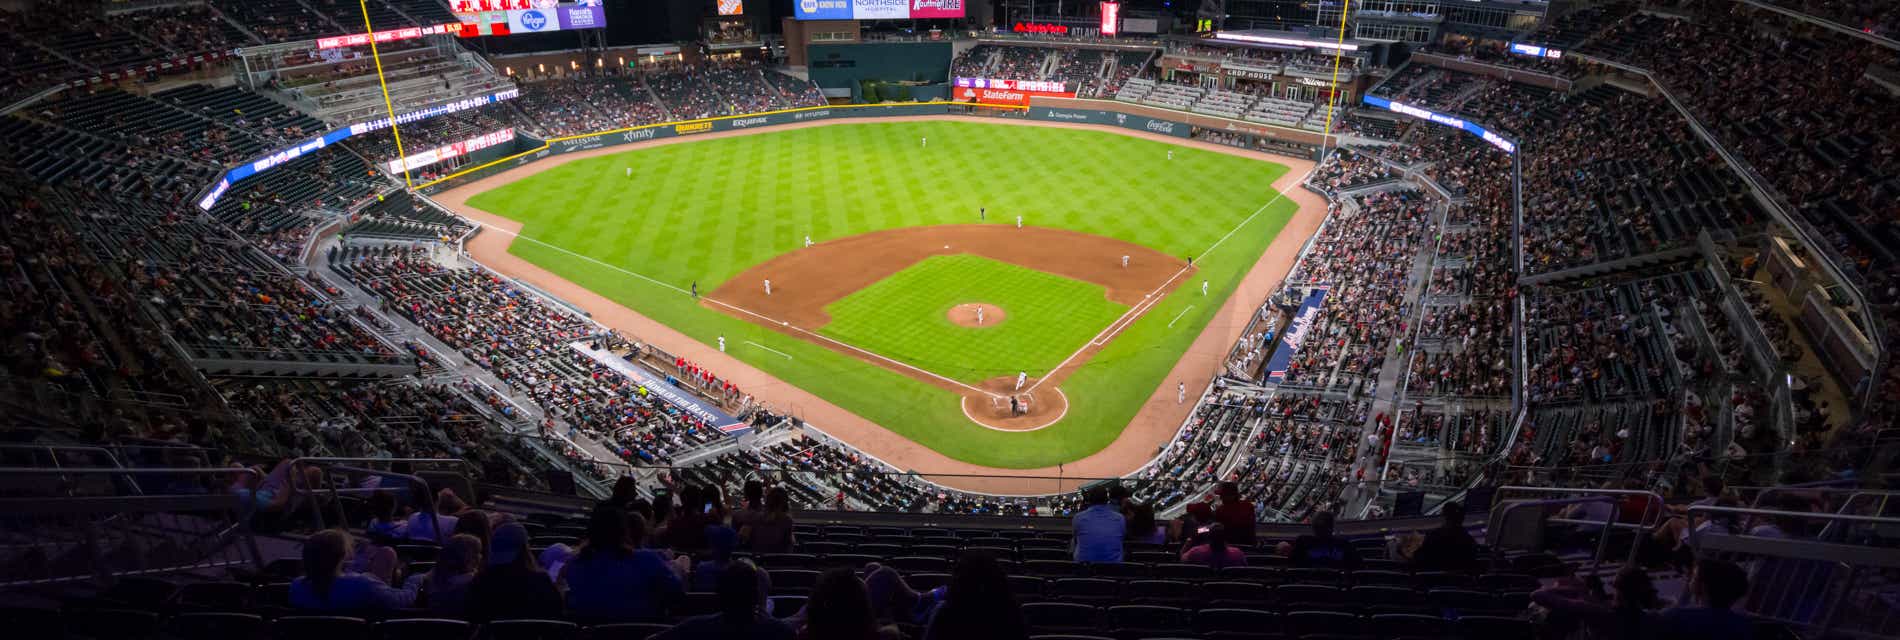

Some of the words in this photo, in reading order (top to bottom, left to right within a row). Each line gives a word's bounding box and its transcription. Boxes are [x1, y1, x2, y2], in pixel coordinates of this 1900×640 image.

[523, 13, 545, 29] Kroger
[1248, 72, 1273, 80] HOUSE
[623, 128, 655, 142] xfinity
